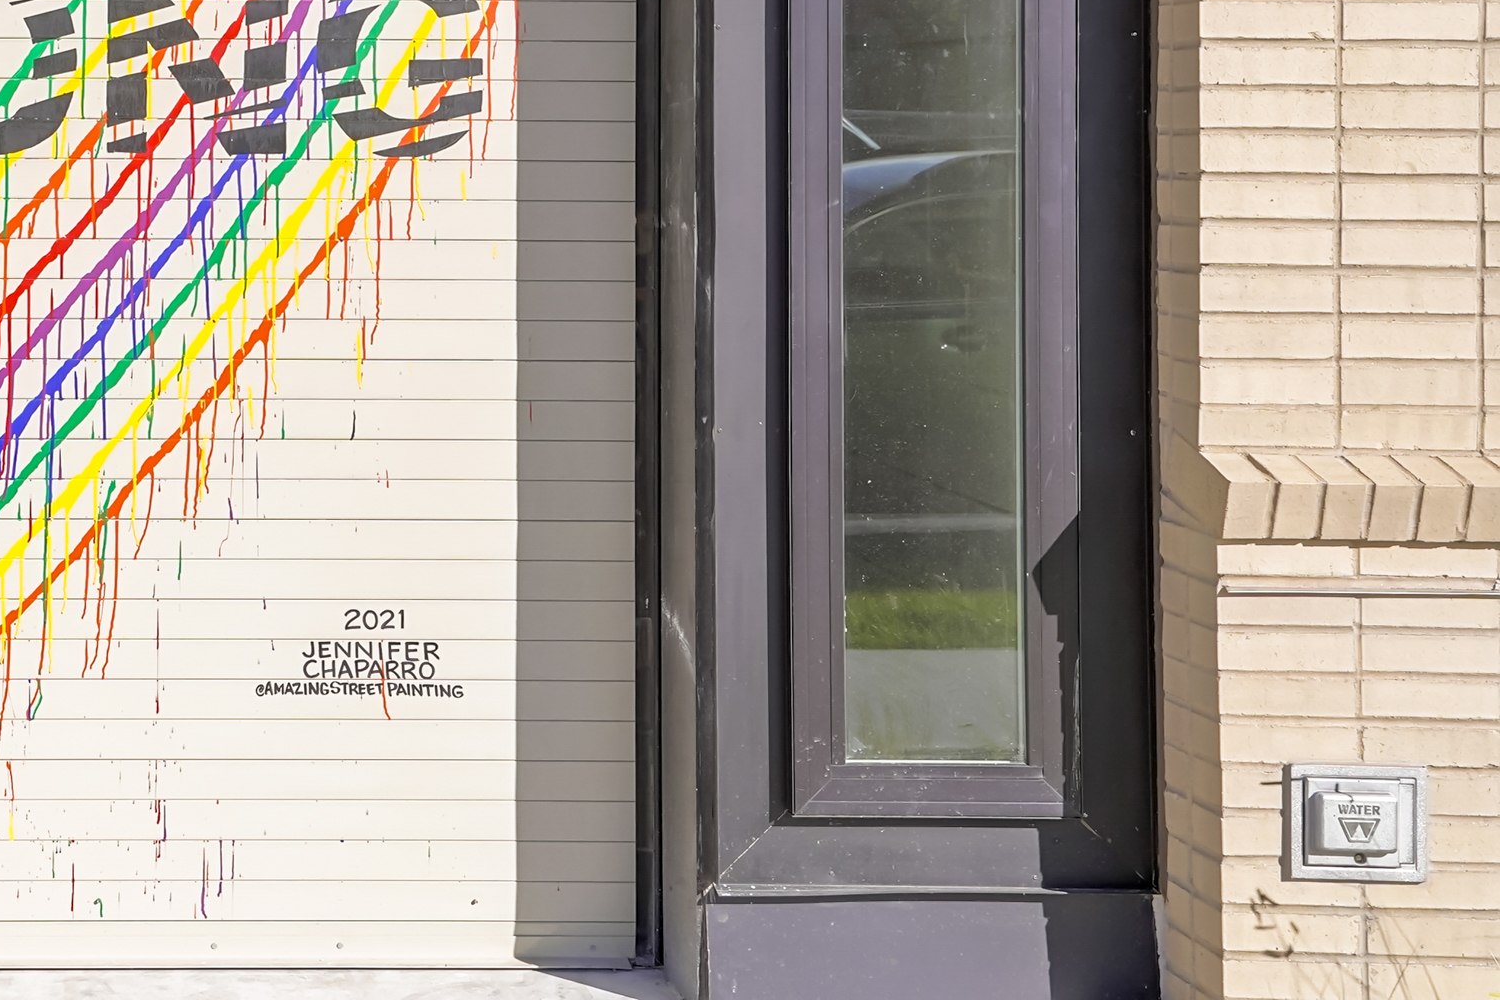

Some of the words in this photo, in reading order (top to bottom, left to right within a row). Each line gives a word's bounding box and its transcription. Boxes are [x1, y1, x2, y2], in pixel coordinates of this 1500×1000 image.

[344, 608, 405, 630] 2021
[301, 641, 440, 661] JENNIFER
[302, 659, 435, 680] CHAPARRO
[1338, 804, 1381, 816] WATER
